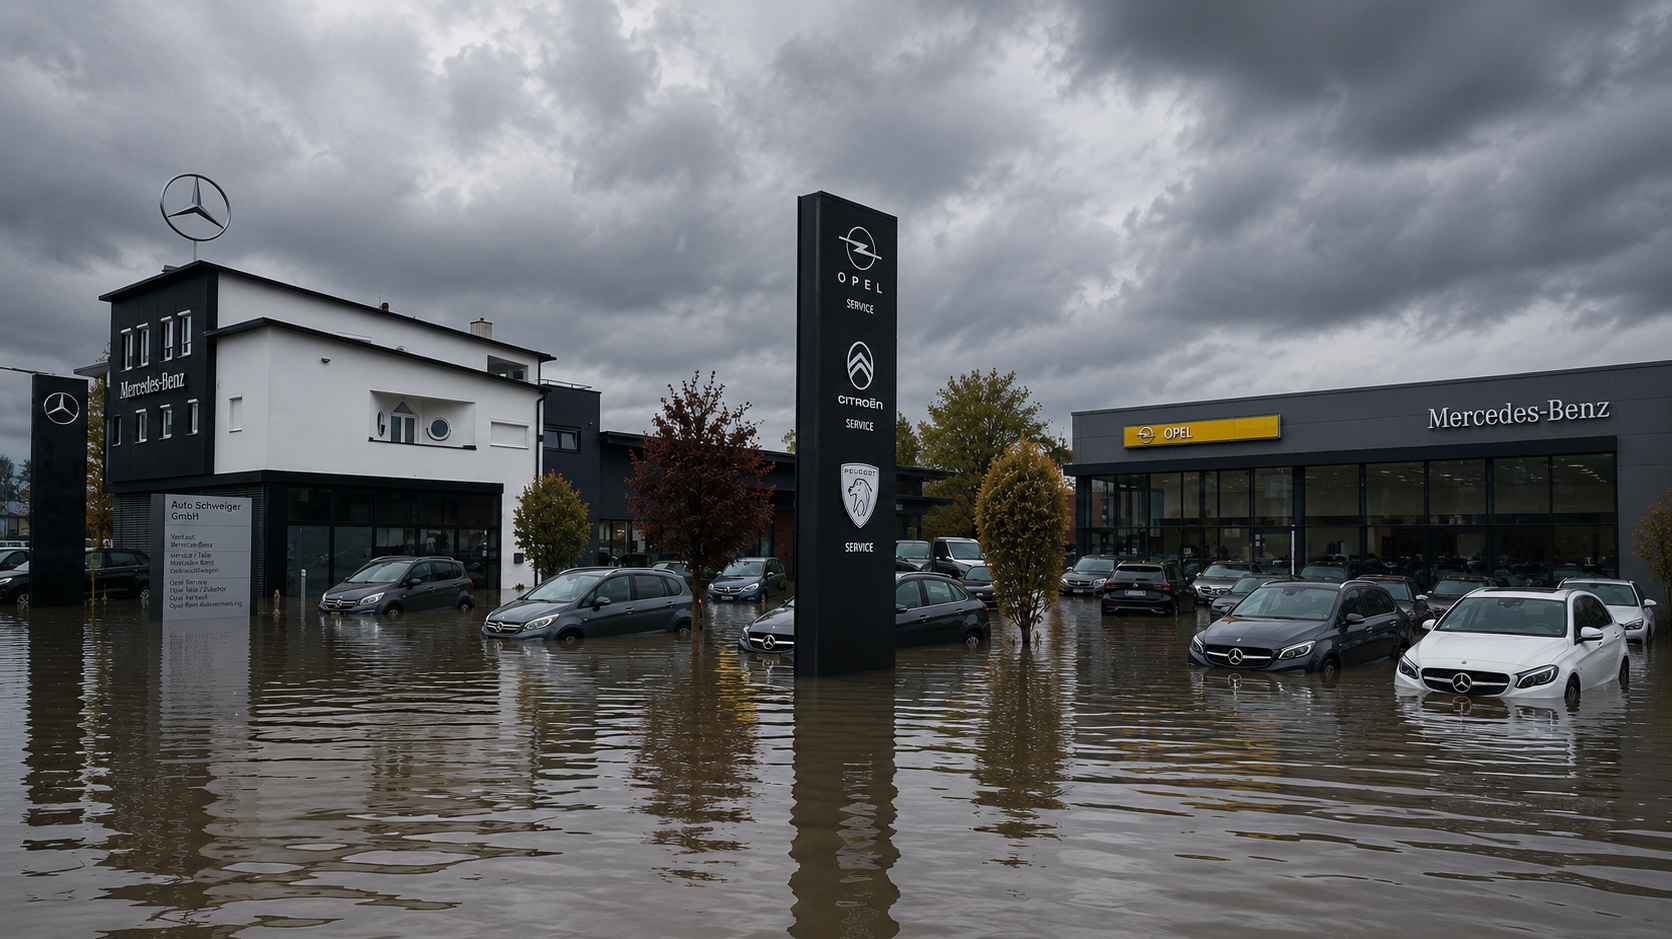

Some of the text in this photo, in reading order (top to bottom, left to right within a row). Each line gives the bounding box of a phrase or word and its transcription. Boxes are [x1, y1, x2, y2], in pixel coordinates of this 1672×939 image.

[837, 271, 883, 295] OPEL
[846, 298, 875, 315] SERVICE
[119, 372, 185, 400] Mercedes-Benz
[1427, 399, 1610, 429] Mercedes-Benz
[845, 418, 875, 432] SERVICE
[1163, 426, 1193, 439] OPEL
[171, 501, 242, 512] Auto Schweiger
[171, 512, 199, 521] GmbH
[845, 542, 874, 553] SERVICE
